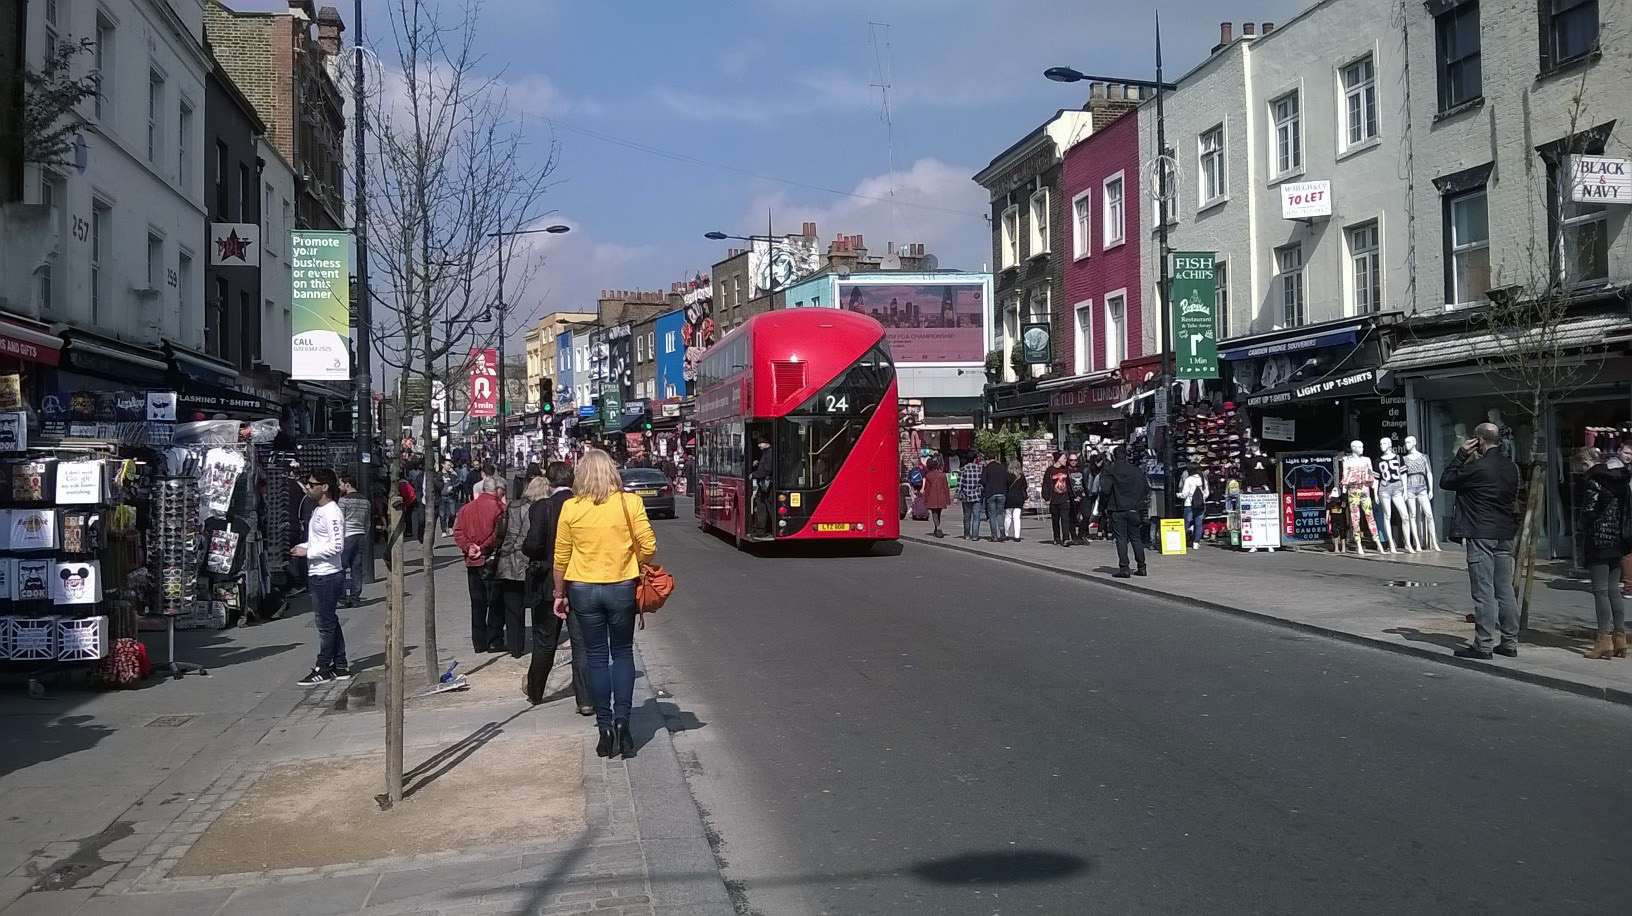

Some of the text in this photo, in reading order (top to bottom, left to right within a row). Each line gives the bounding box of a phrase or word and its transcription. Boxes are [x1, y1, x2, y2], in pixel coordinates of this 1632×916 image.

[1581, 161, 1624, 175] BLACK
[1599, 175, 1606, 184] &
[1583, 185, 1620, 198] NAVY
[1288, 191, 1324, 206] TO LET
[72, 214, 89, 243] 257
[293, 236, 340, 247] Promote
[293, 247, 318, 257] your
[293, 258, 341, 268] business
[1175, 258, 1213, 269] FISH
[167, 268, 178, 289] 259
[293, 270, 340, 278] or event
[293, 279, 331, 288] on this
[293, 289, 332, 299] banner
[294, 338, 314, 346] CALL
[7, 340, 20, 353] AND
[20, 343, 37, 358] GIFTS
[1296, 371, 1373, 397] LIGHT UP T-SHIRTS
[175, 393, 217, 404] FLASHING
[220, 398, 261, 408] T-SHIRTS
[826, 395, 849, 413] 24
[1380, 396, 1406, 405] Bureau
[1389, 408, 1399, 416] de
[1381, 420, 1407, 428] Change
[1391, 432, 1399, 441] &
[1379, 460, 1400, 481] 85
[1285, 496, 1293, 534] SALE
[1295, 518, 1326, 526] CYBER
[22, 589, 45, 598] COOK
